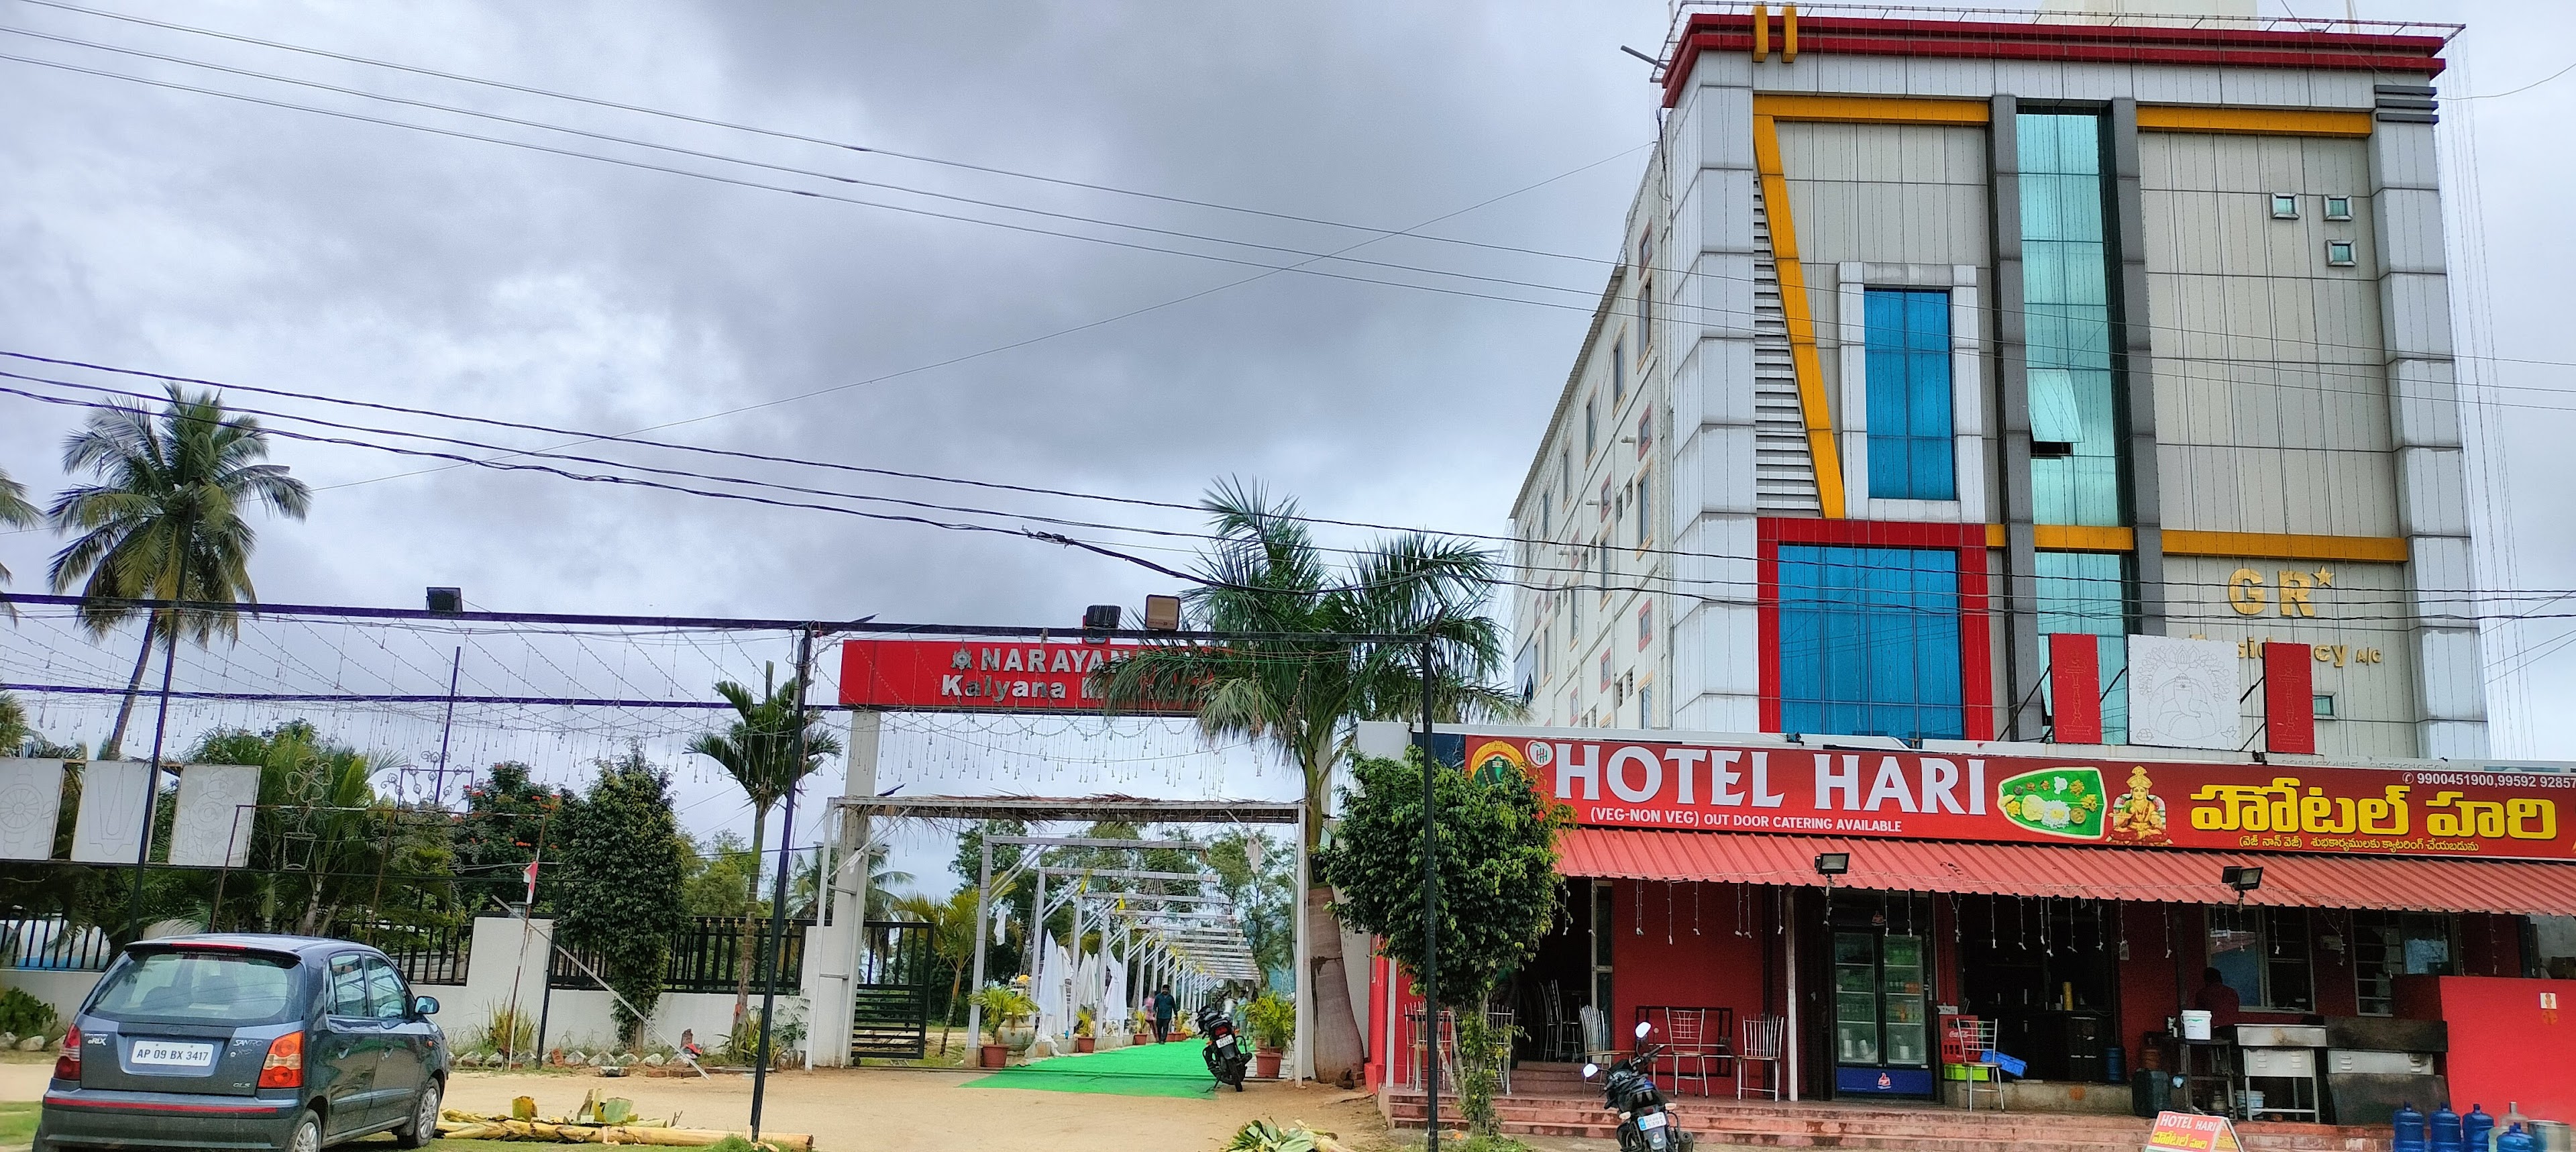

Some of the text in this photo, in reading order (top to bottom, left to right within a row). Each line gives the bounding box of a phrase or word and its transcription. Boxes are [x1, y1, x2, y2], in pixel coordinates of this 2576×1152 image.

[2229, 568, 2314, 617] GR
[981, 647, 1132, 674] NARAYAN
[941, 674, 1066, 702] Kalyana
[1554, 742, 1987, 815] HOTEL HARI
[1591, 806, 1902, 833] (VEG-NON VEG) OUT DOOR CATERING AVAILABLE
[2190, 777, 2557, 840] హోటల్ హరి
[2262, 835, 2282, 847] నాన్
[2310, 837, 2381, 852] శుభకార్యములకు
[2382, 837, 2424, 853] క్యాటరింగ్
[2425, 838, 2479, 851] చేయబడును
[136, 1049, 209, 1061] AP 09 BX 3417
[2159, 1114, 2218, 1132] HOTEL HARI
